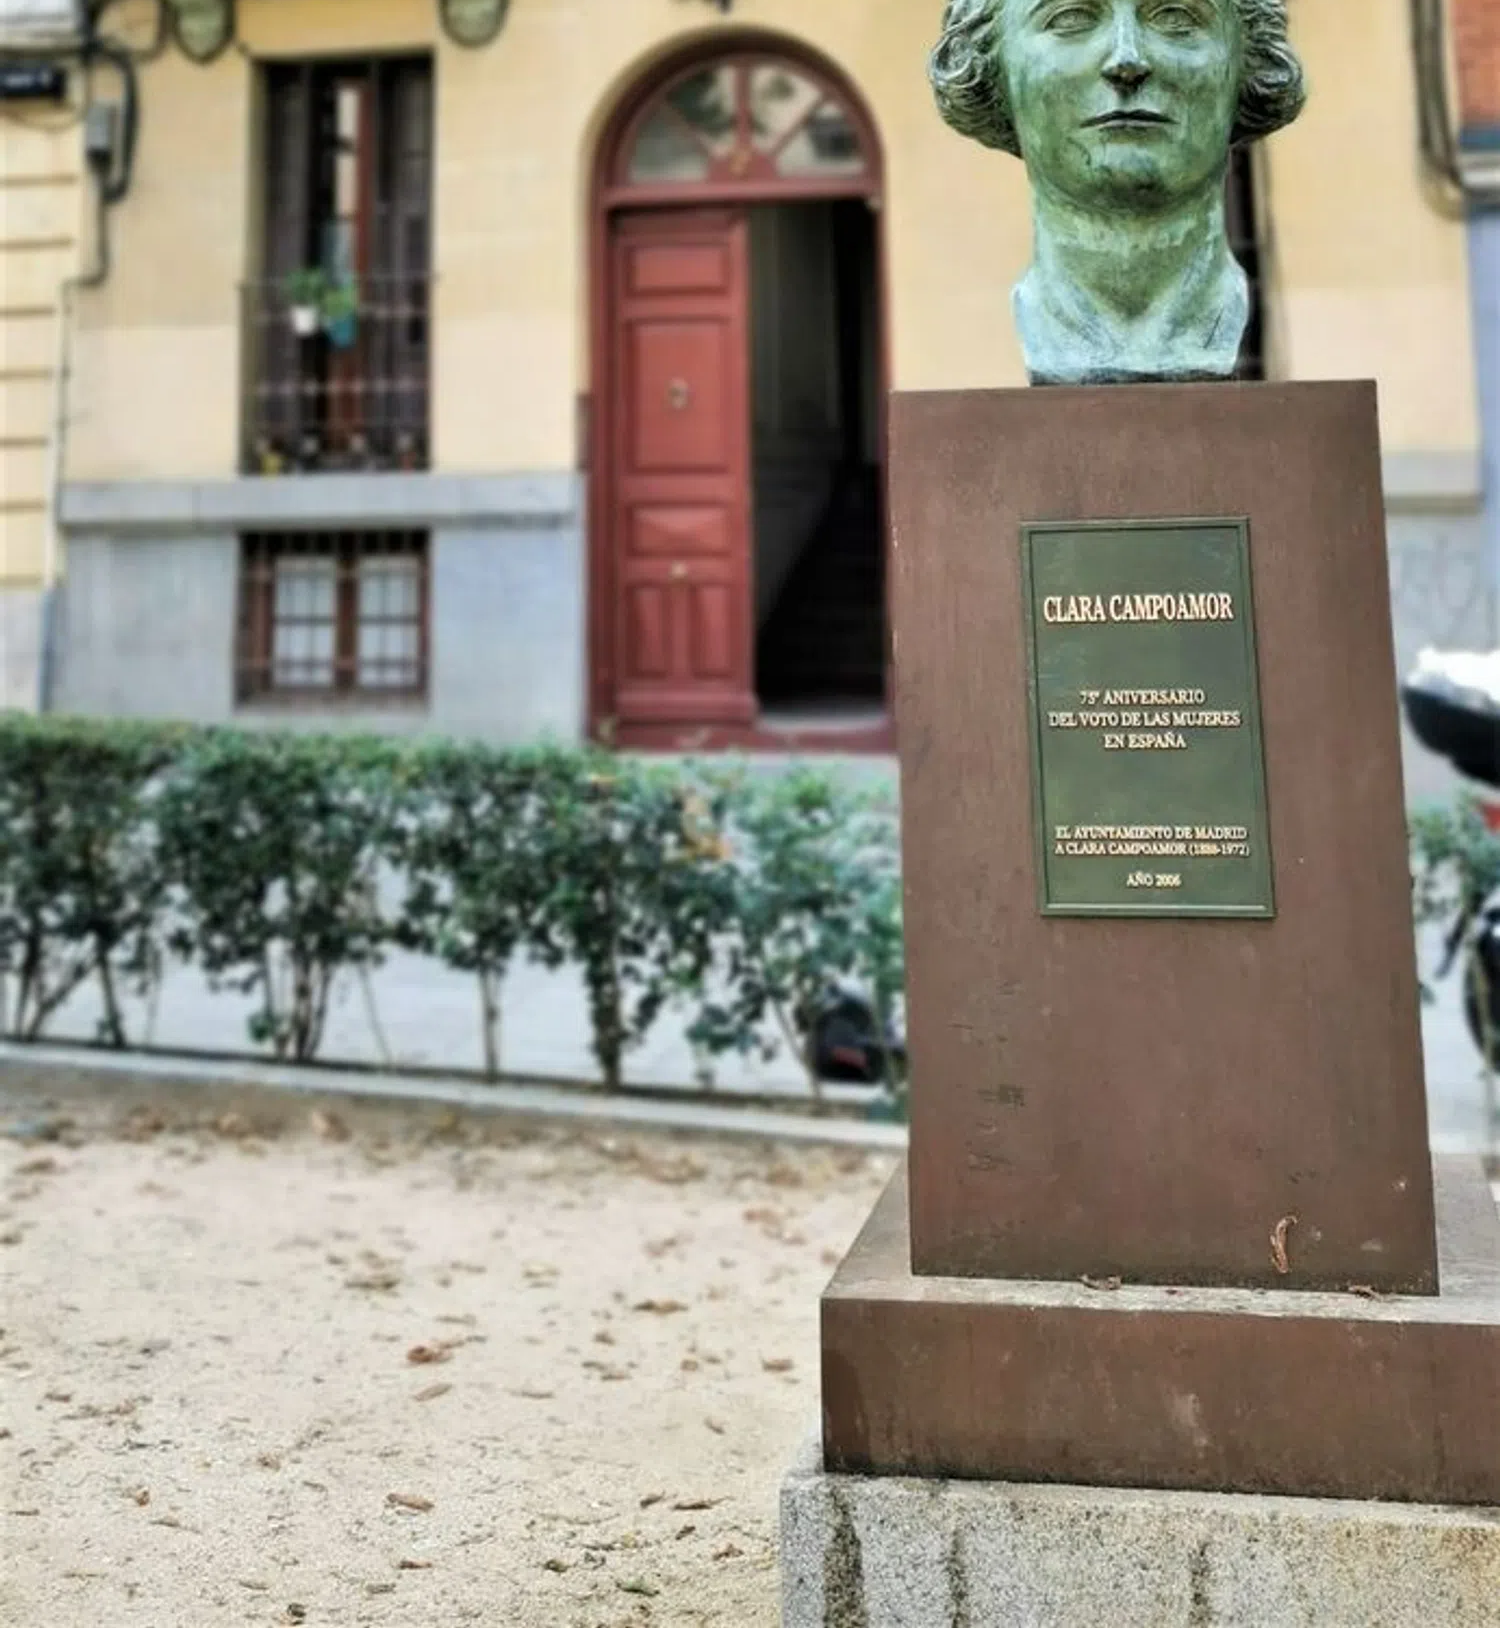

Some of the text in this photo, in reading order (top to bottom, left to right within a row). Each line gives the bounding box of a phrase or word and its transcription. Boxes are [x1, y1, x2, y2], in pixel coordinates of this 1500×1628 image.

[1044, 592, 1234, 623] CLARA CAMPOAMOR
[1103, 689, 1206, 705] ANIVERSARIO
[1049, 711, 1241, 727] DEL VOTO DE LAS MUJERES
[1104, 731, 1187, 749] EN ESPAÑA
[1055, 826, 1248, 840] EL AYUNTAMIENTO DE MADRID
[1055, 842, 1065, 855] A
[1067, 842, 1107, 855] CLARA
[1109, 842, 1187, 855] CAMPOAMOR
[1127, 871, 1181, 887] AÑO 2006
